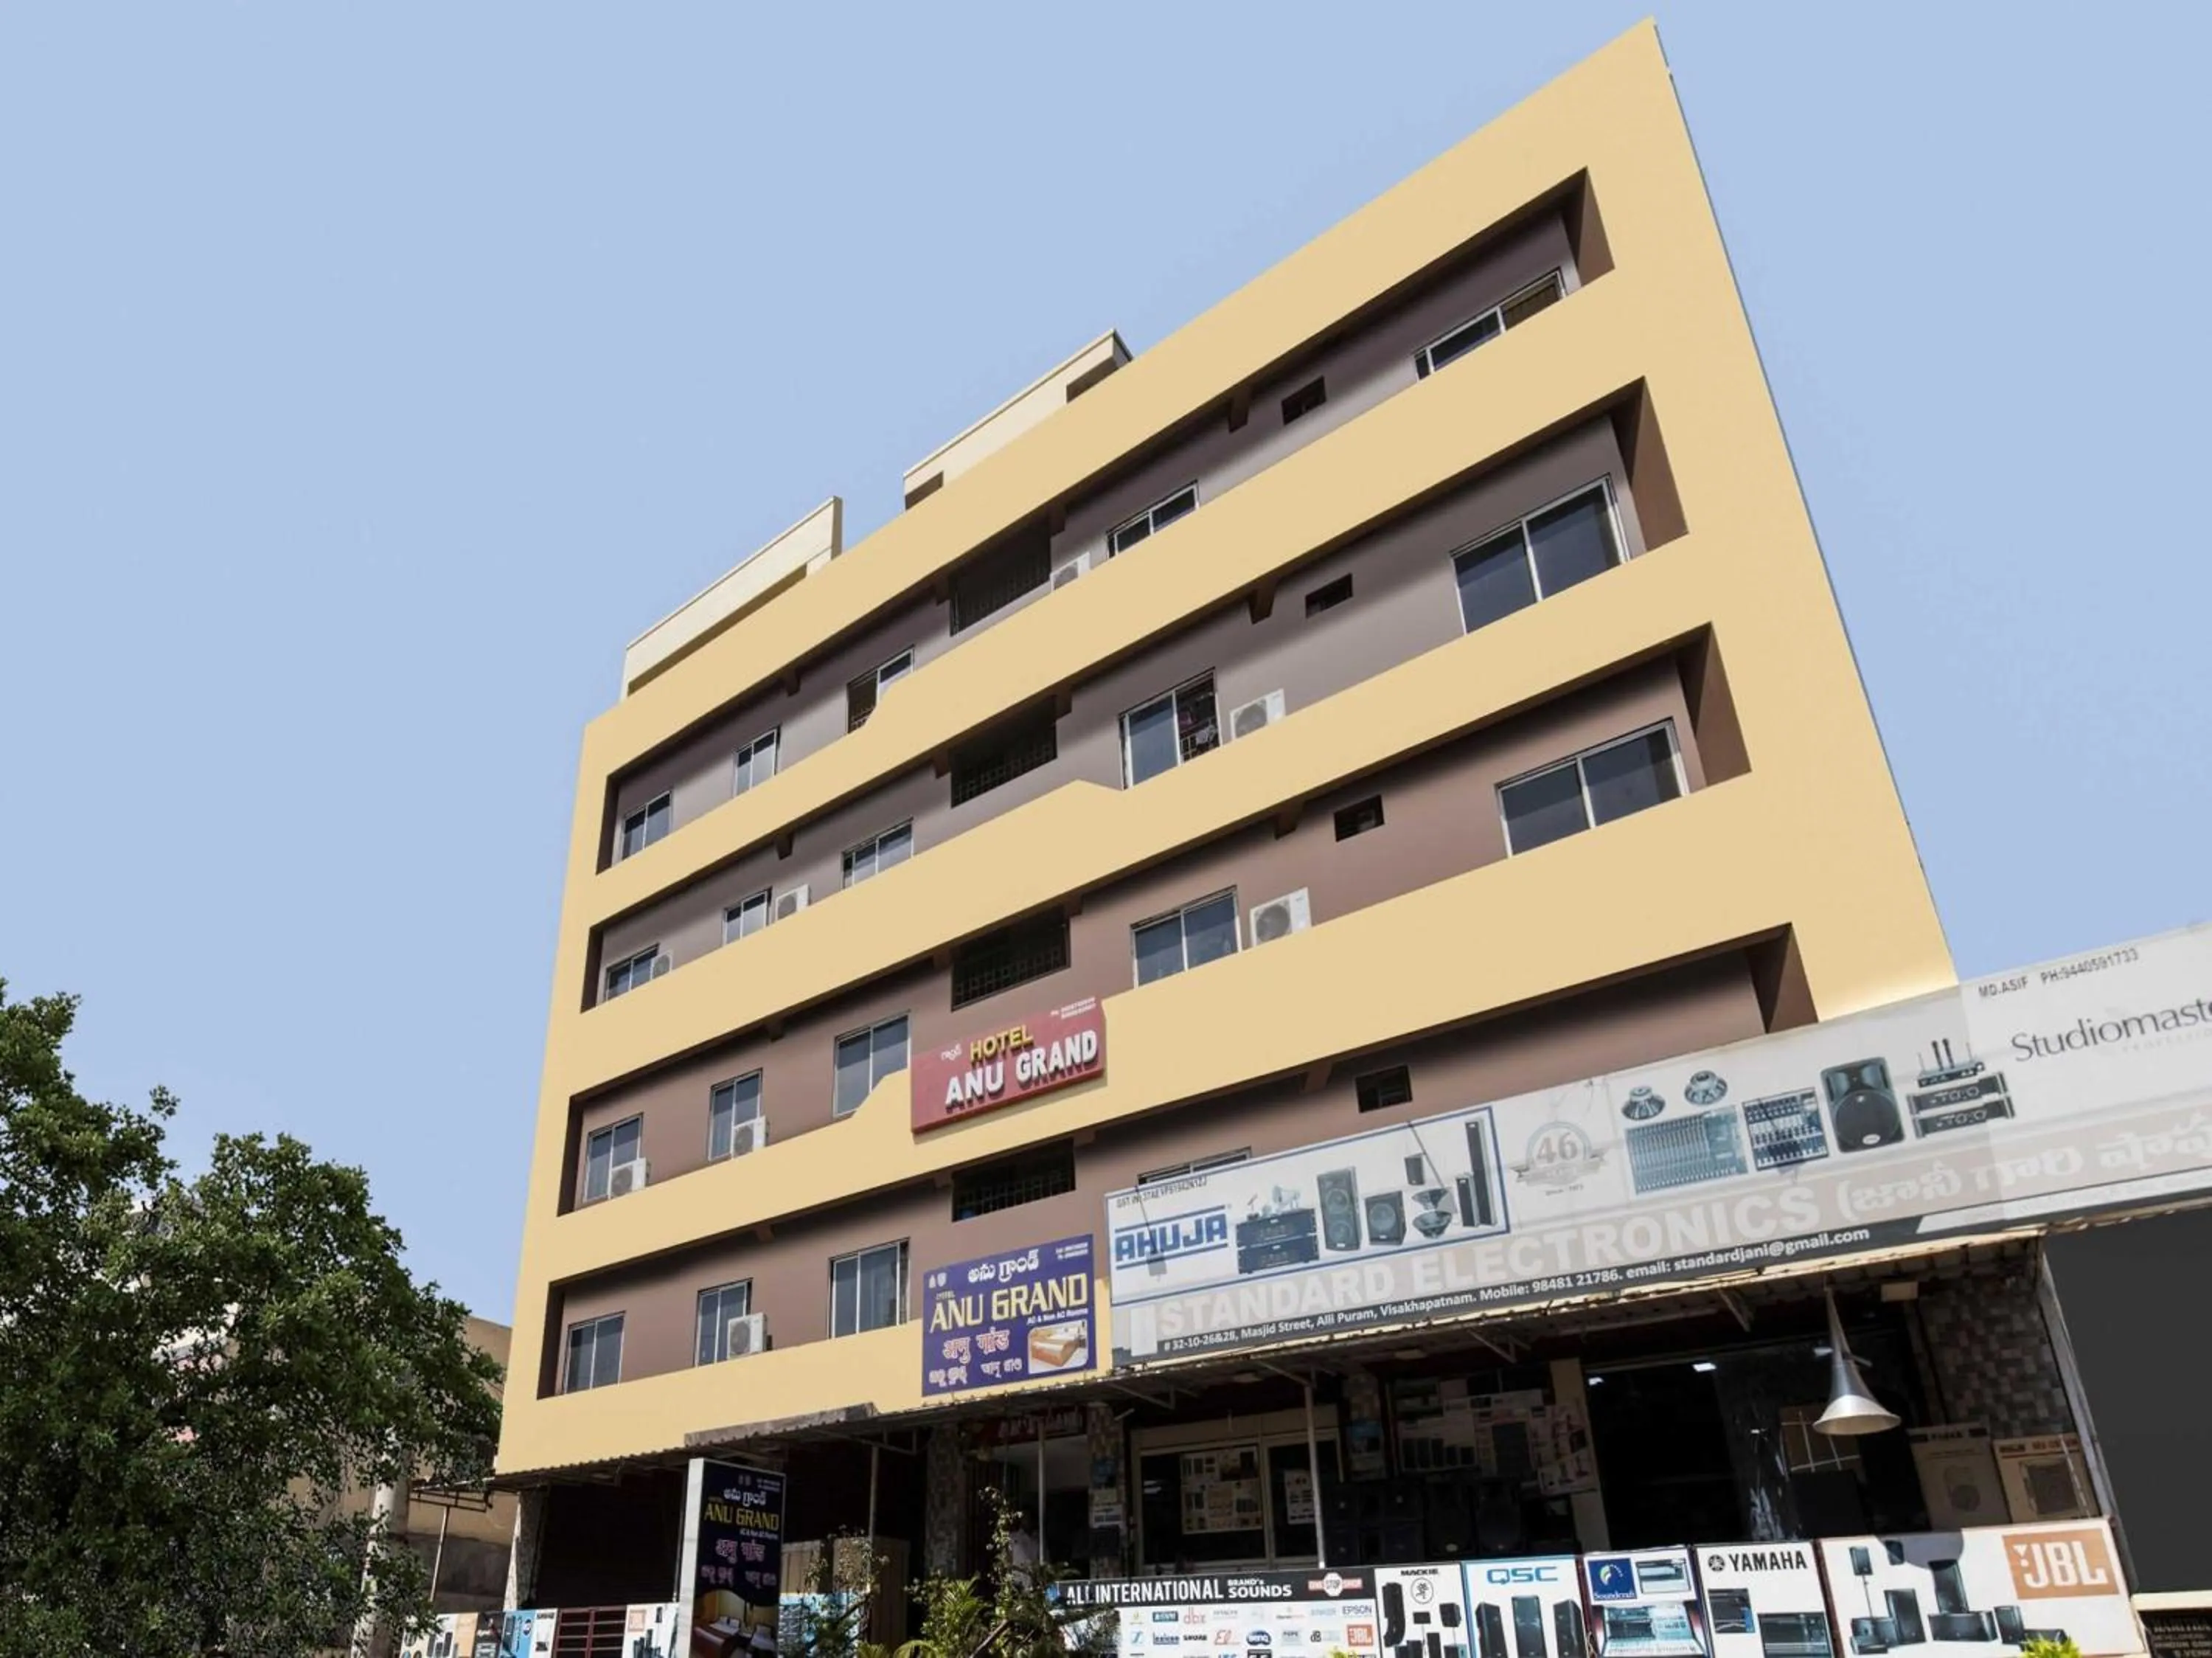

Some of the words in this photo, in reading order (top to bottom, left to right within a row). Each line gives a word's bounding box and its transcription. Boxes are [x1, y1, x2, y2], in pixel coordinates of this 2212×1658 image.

[970, 1024, 1034, 1062] HOTEL
[2011, 999, 2212, 1061] Studiomast
[945, 1061, 1004, 1106] ANU
[1015, 1030, 1098, 1083] GRAND
[1536, 1132, 1578, 1164] 46
[1115, 1213, 1228, 1262] AHUJA
[1158, 1263, 1395, 1335] STANDARD
[1413, 1187, 1820, 1293] ELECTRONICS
[1241, 1323, 1276, 1339] Masjid
[1279, 1318, 1315, 1333] Street,
[1317, 1314, 1335, 1327] Alli
[1337, 1309, 1377, 1323] Puram,
[1380, 1294, 1477, 1317] Visakhapatnam.
[1480, 1284, 1529, 1300] Mobile:
[1532, 1276, 1573, 1291] 98481
[1576, 1269, 1623, 1286] 21786.
[1626, 1261, 1671, 1278] email:
[1674, 1228, 1870, 1271] standardjani@gmail.com
[930, 1294, 984, 1333] ANU
[992, 1273, 1088, 1321] GRAND
[704, 1503, 733, 1523] ANU
[736, 1508, 779, 1531] GRAND
[1400, 1568, 1439, 1576] MACKIE
[1487, 1567, 1558, 1584] QSC
[1728, 1550, 1807, 1572] YAMAHA
[2023, 1541, 2109, 1589] JBL
[1095, 1578, 1224, 1603] INTERNATIONAL
[1228, 1584, 1293, 1599] SOUNDS
[1342, 1604, 1372, 1615] EPSON
